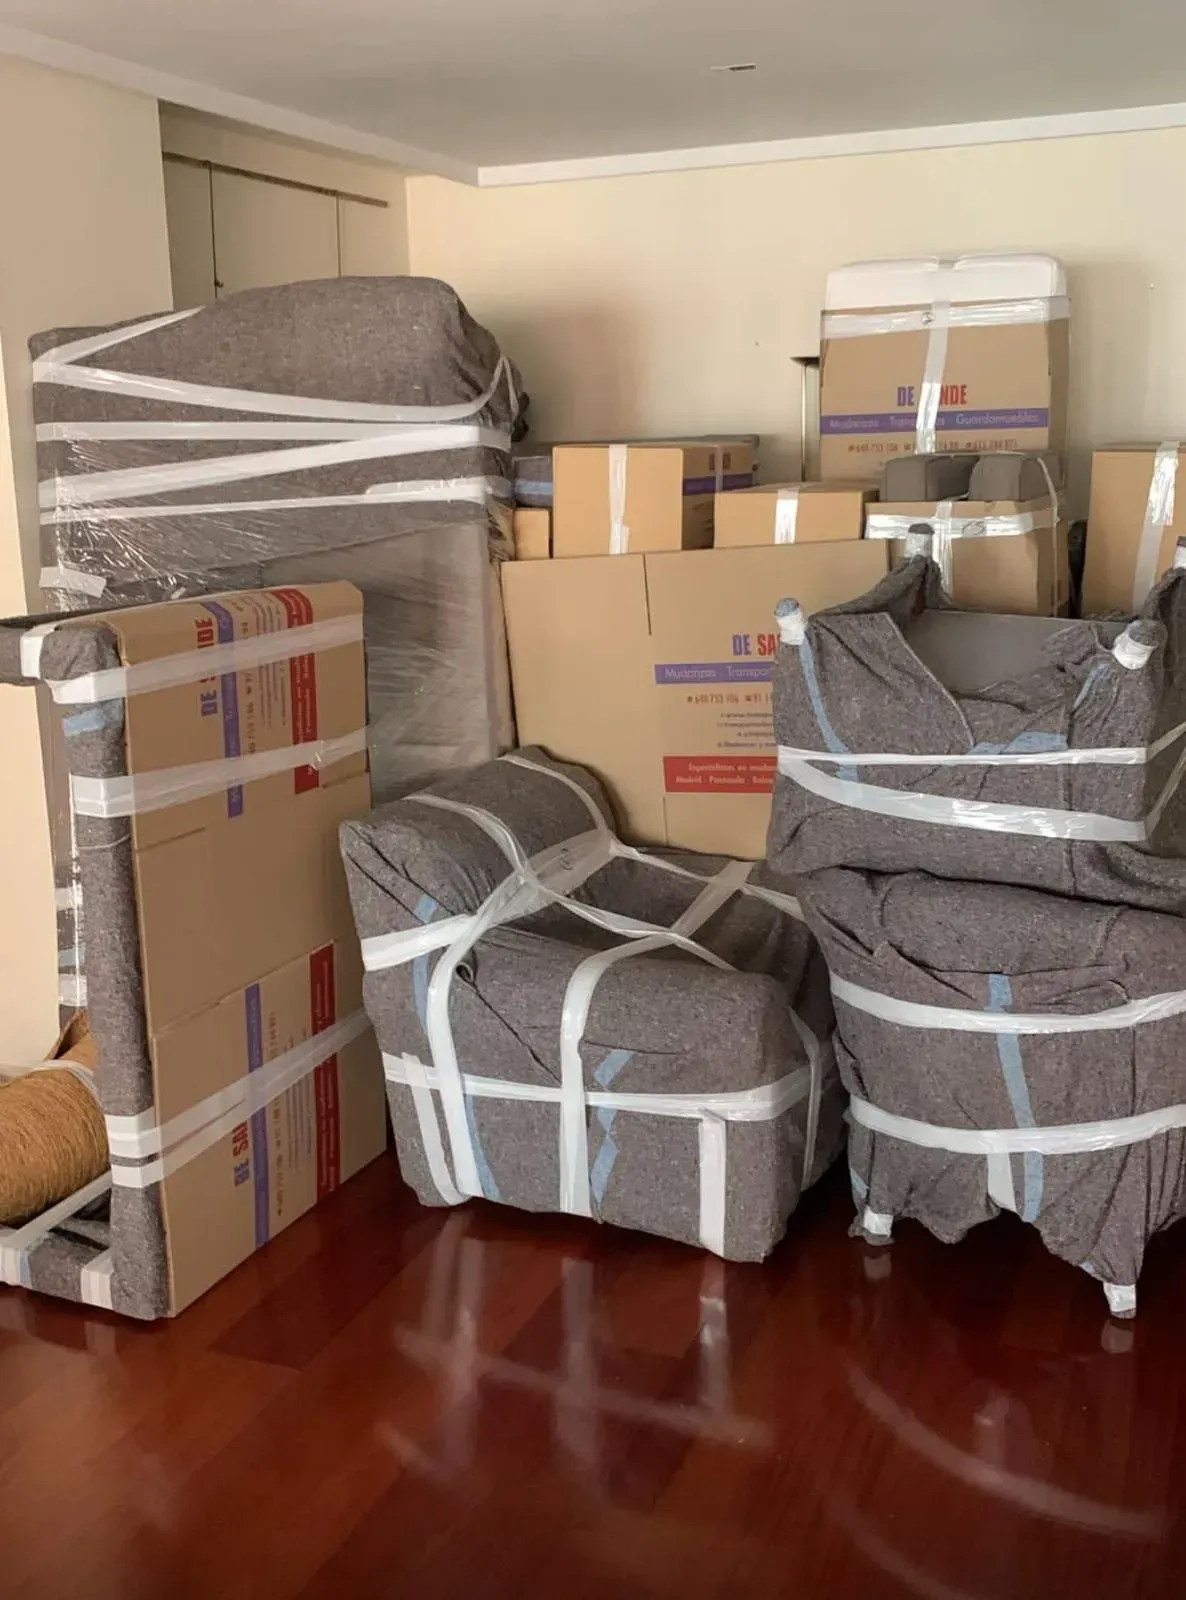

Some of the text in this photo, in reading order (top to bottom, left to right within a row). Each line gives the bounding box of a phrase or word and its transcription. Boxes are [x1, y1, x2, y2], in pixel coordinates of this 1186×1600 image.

[896, 386, 915, 407] DE
[732, 633, 781, 656] DE SA
[726, 663, 773, 679] Transpor
[201, 690, 218, 717] DE
[234, 1158, 250, 1187] DE
